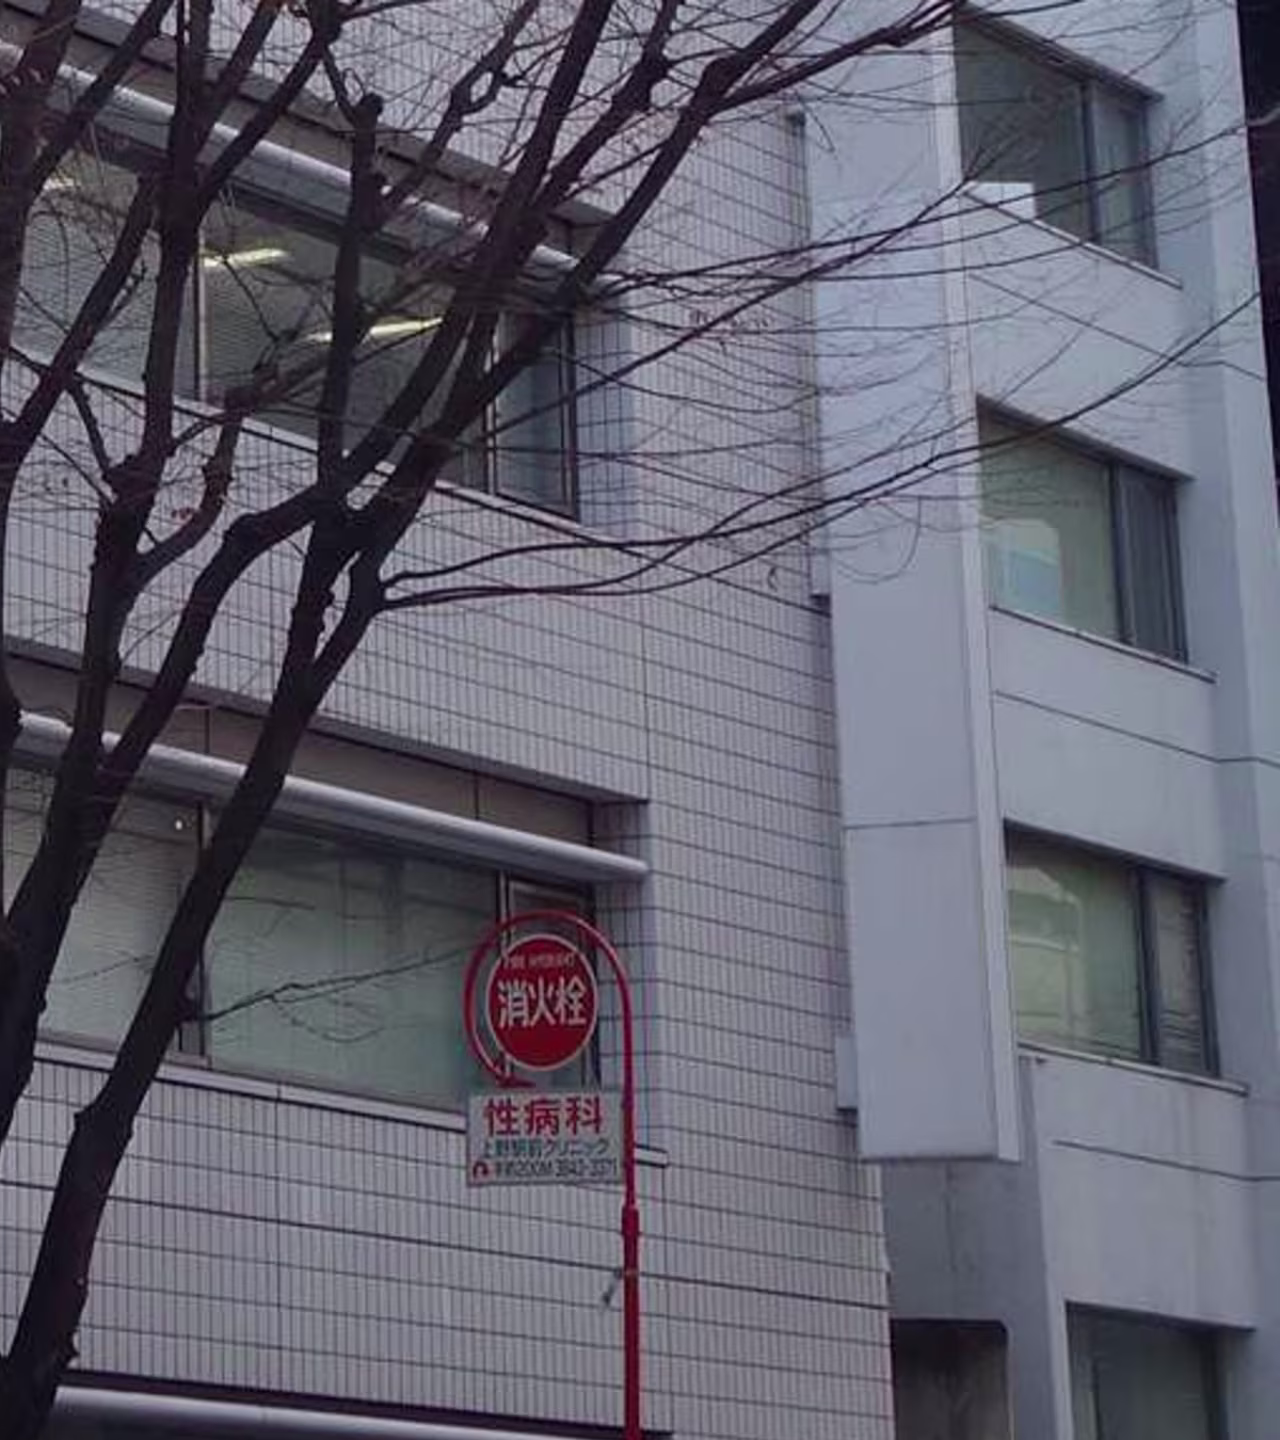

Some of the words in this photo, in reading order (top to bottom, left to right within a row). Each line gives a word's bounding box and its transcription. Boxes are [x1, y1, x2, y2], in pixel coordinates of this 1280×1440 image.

[497, 976, 587, 1028] 消火栓
[484, 1095, 602, 1137] 性病科
